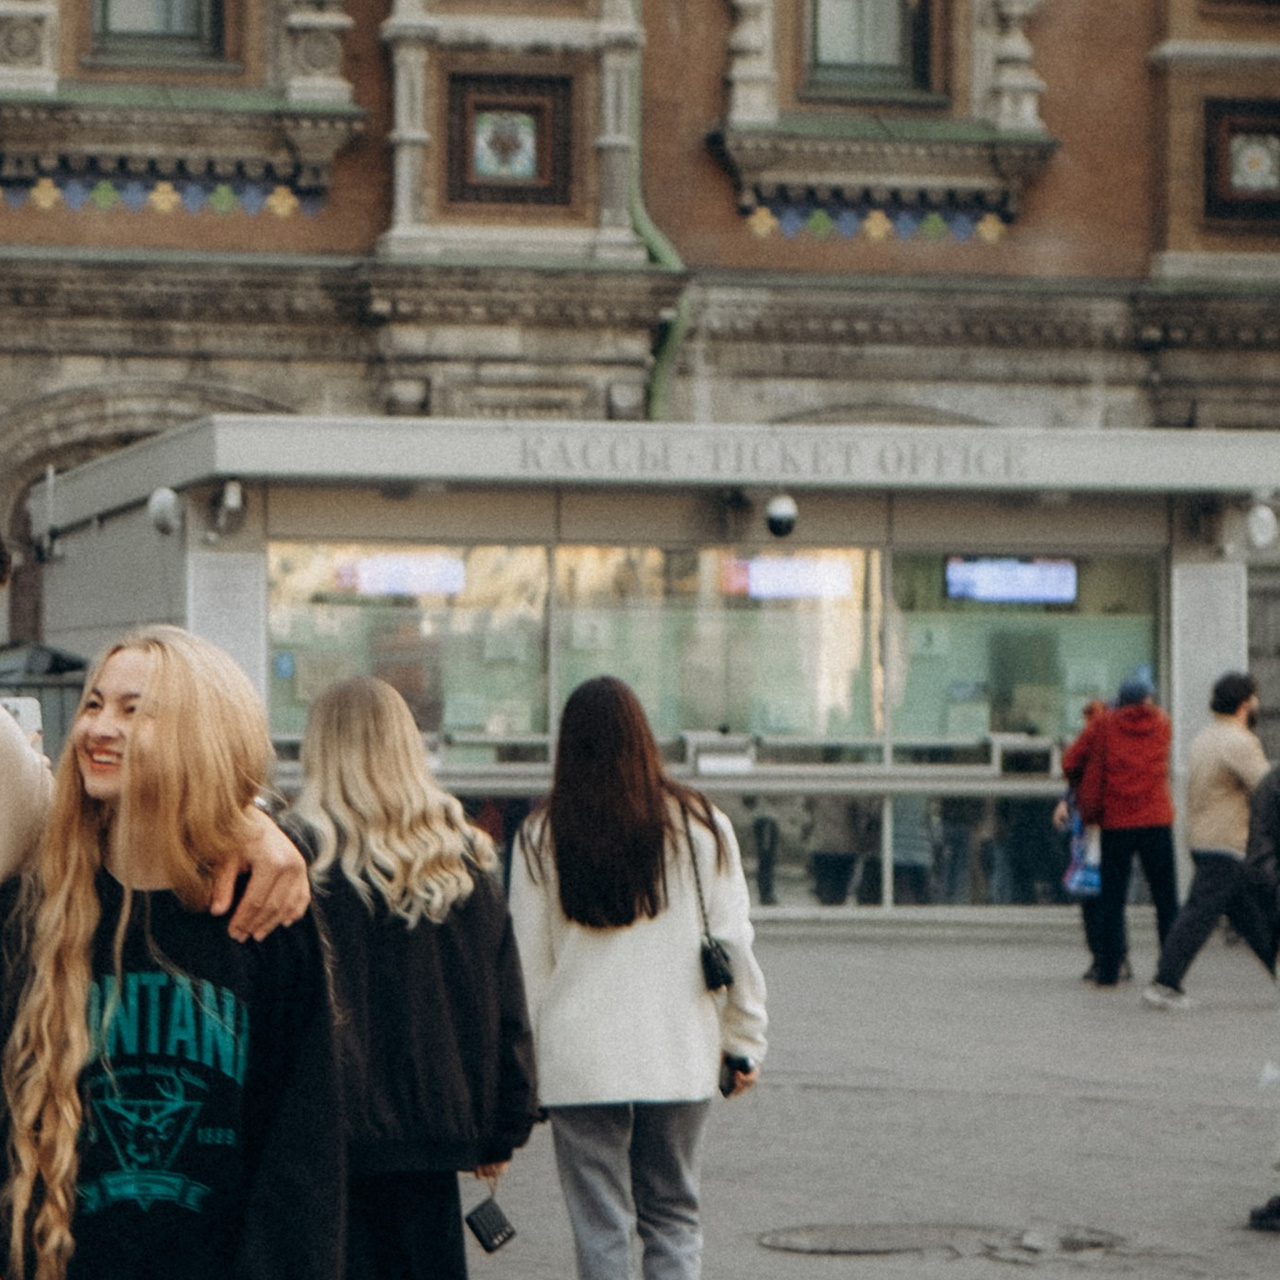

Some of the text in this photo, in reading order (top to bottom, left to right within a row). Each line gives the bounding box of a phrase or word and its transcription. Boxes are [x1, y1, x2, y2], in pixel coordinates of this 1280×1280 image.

[520, 437, 670, 471] КАССЫ
[706, 439, 1025, 477] TICKET OFFICE
